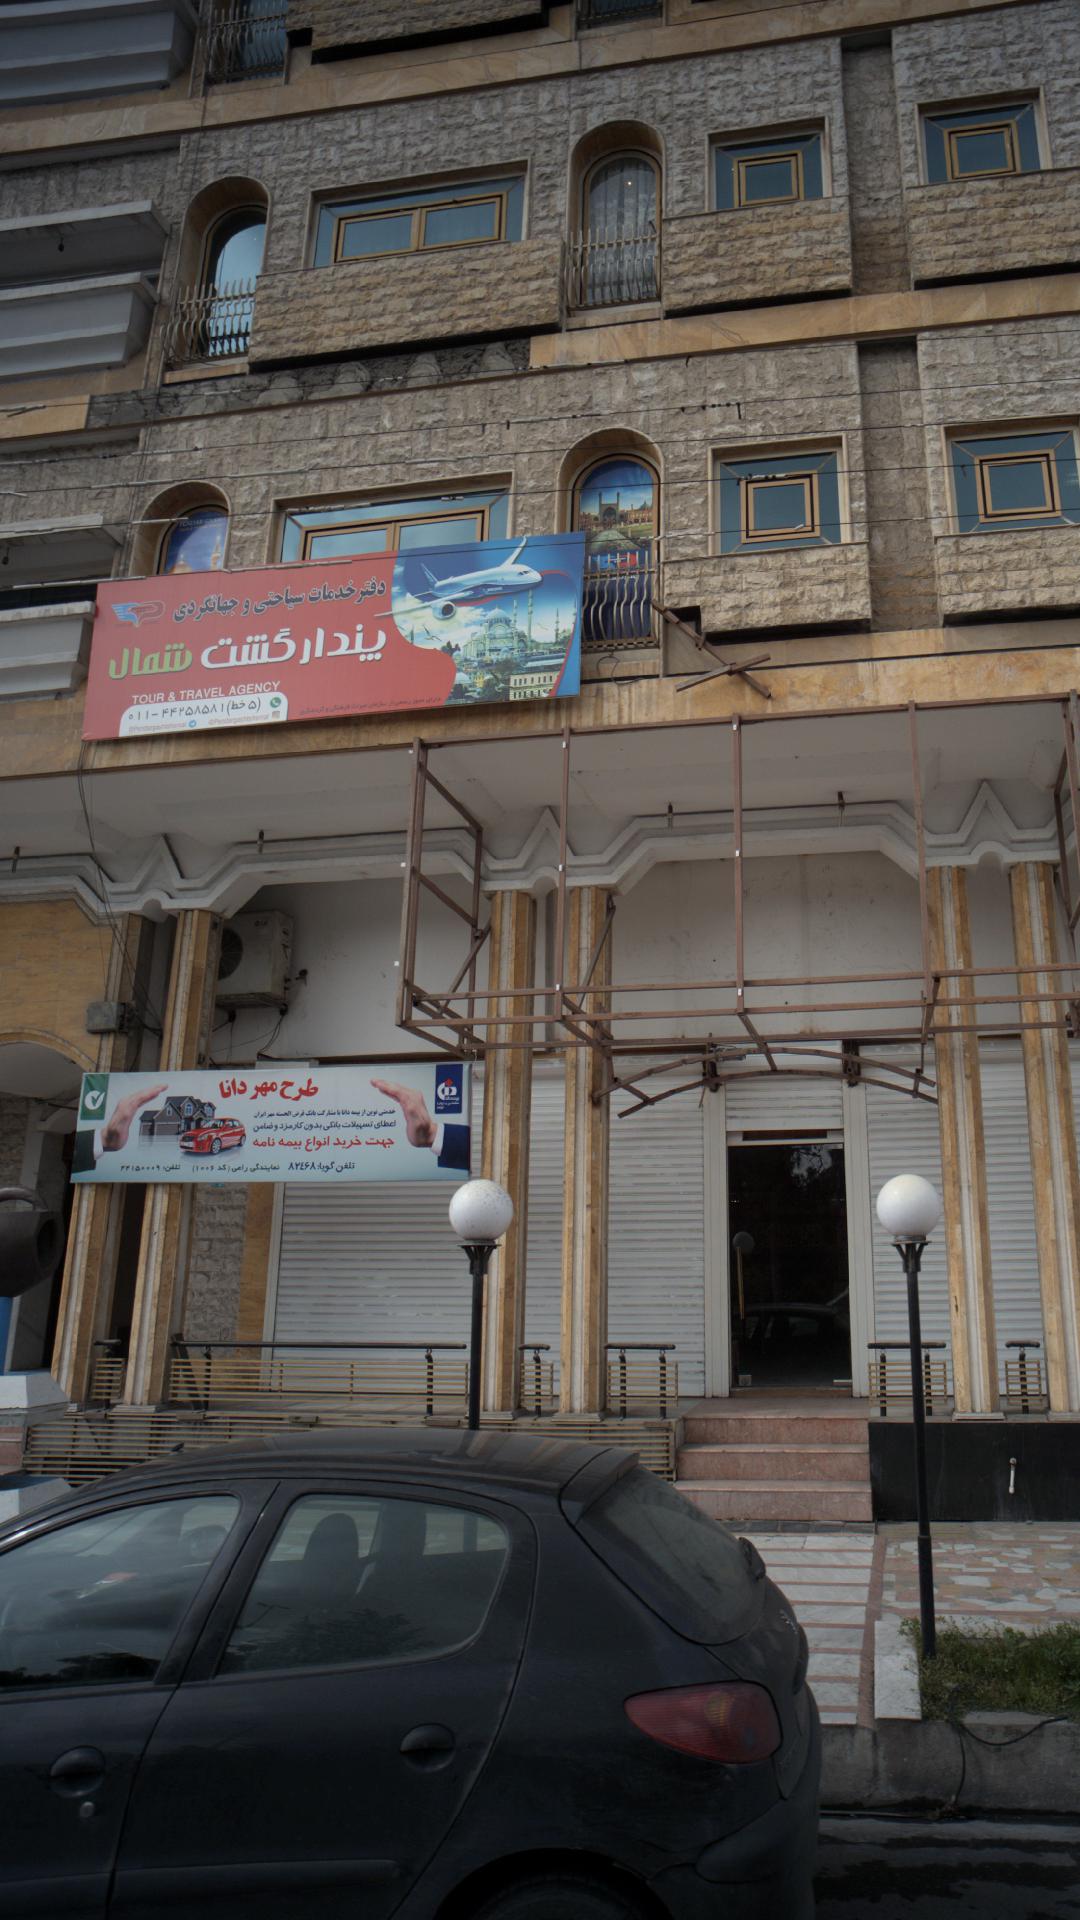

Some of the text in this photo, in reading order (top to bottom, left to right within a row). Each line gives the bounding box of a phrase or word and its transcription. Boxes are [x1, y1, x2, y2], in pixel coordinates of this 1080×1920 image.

[173, 576, 386, 623] دفتر خدمات سیاحتی و جهانگردی
[108, 643, 194, 679] شمال
[132, 680, 281, 705] TOUR & TRAVEL AGENCY
[218, 1077, 319, 1101] طرح مهر دانا
[253, 1122, 274, 1132] ضامن
[303, 1121, 323, 1131] بدون
[323, 1120, 341, 1131] بانکی
[342, 1120, 373, 1130] تسهیلات
[374, 1119, 396, 1130] اعطای
[252, 1135, 395, 1152] جهت خرید انواع بیمه نامه
[249, 1163, 280, 1173] نمایندگی
[335, 1161, 356, 1173] تلفن
